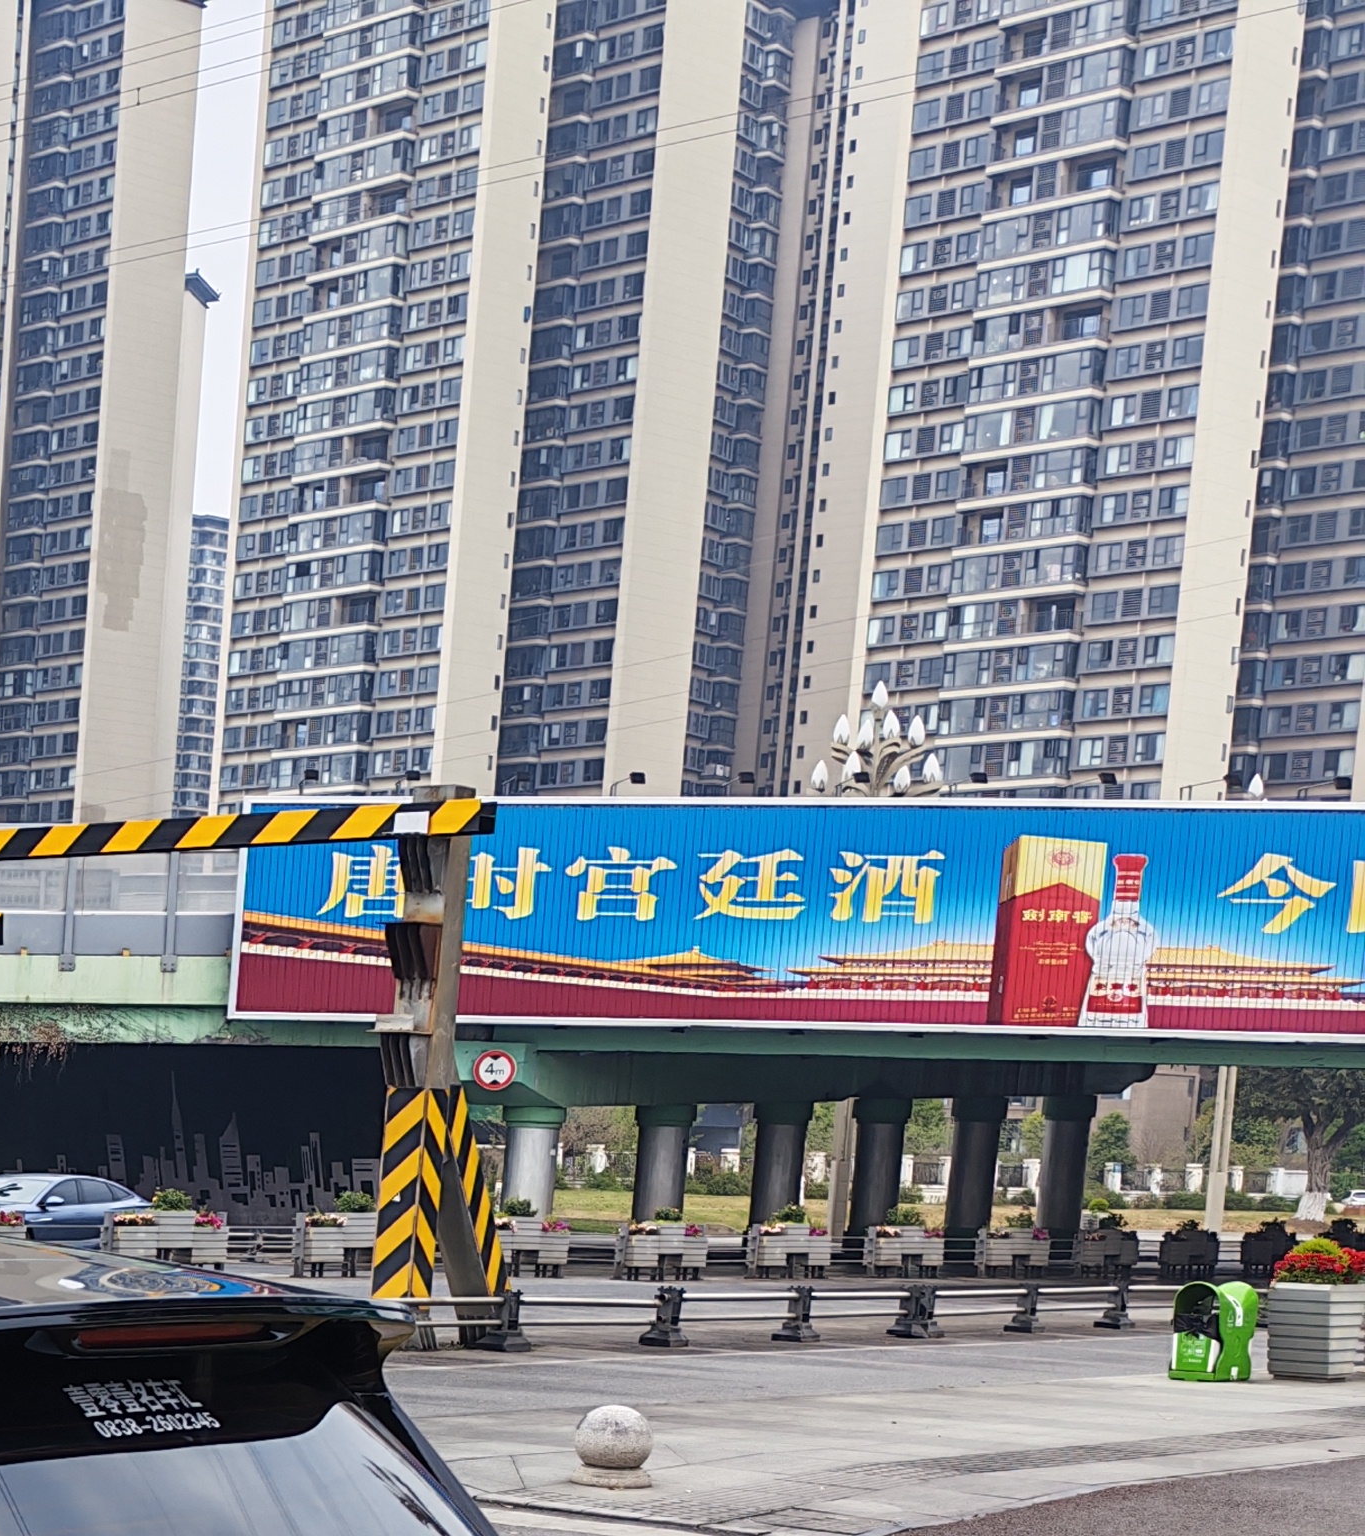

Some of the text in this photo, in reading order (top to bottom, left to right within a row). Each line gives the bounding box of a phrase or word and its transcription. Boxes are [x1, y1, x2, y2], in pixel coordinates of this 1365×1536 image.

[316, 845, 1365, 934] 唐时宫廷酒 今
[484, 1062, 505, 1076] 4m
[62, 1378, 204, 1418] 壹零壹名车汇
[93, 1411, 221, 1438] 0838-2602345
